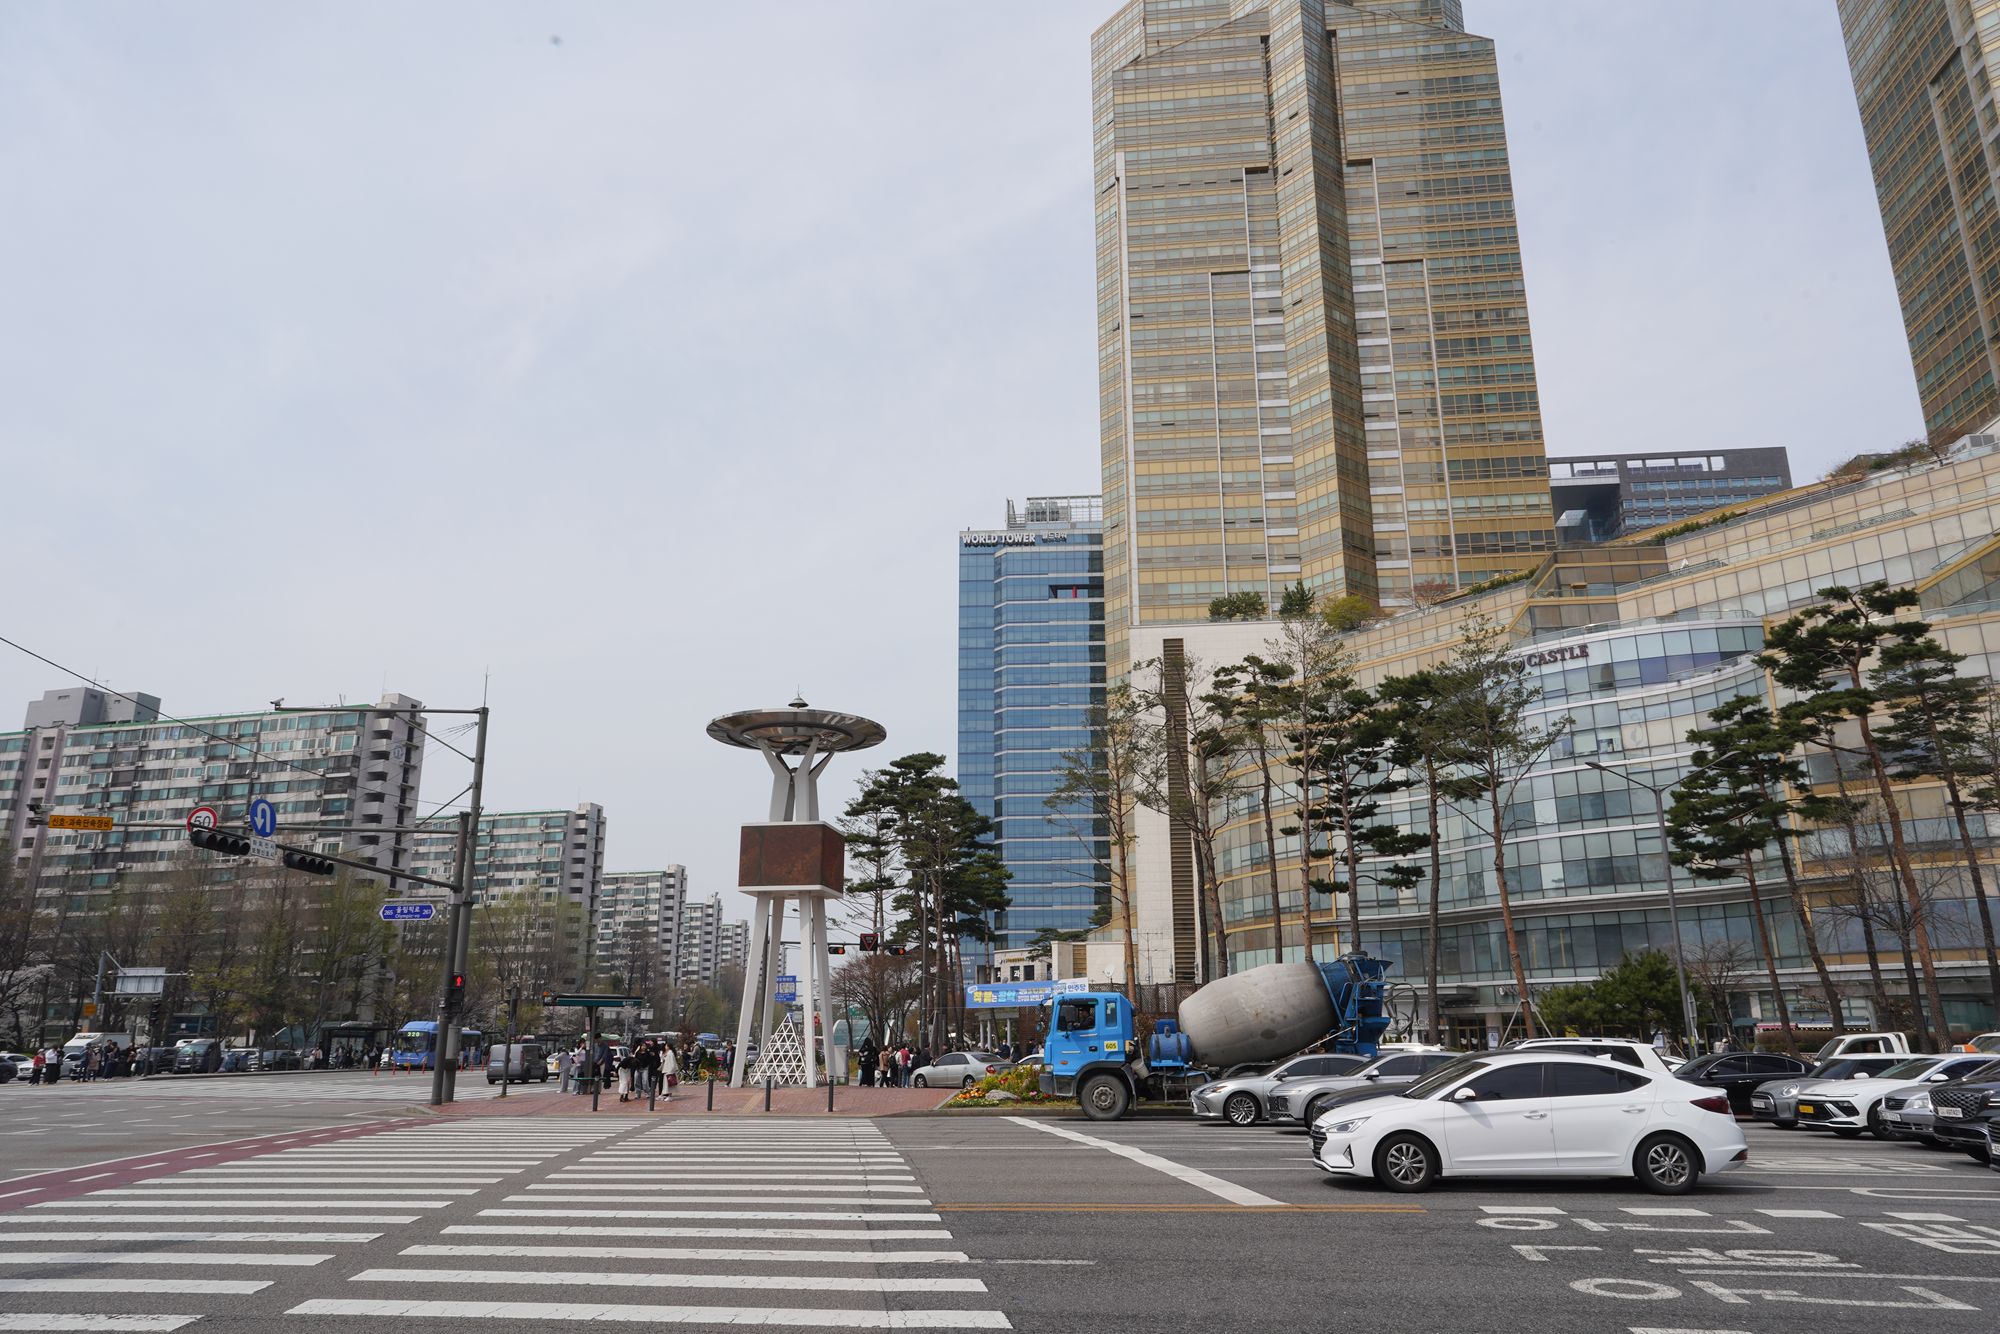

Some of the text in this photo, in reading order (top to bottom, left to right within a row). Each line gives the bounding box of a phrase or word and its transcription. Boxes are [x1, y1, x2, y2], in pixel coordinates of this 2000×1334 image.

[962, 532, 1036, 544] WORLD TOWER
[1526, 644, 1589, 667] CASTLE
[194, 815, 212, 829] 50
